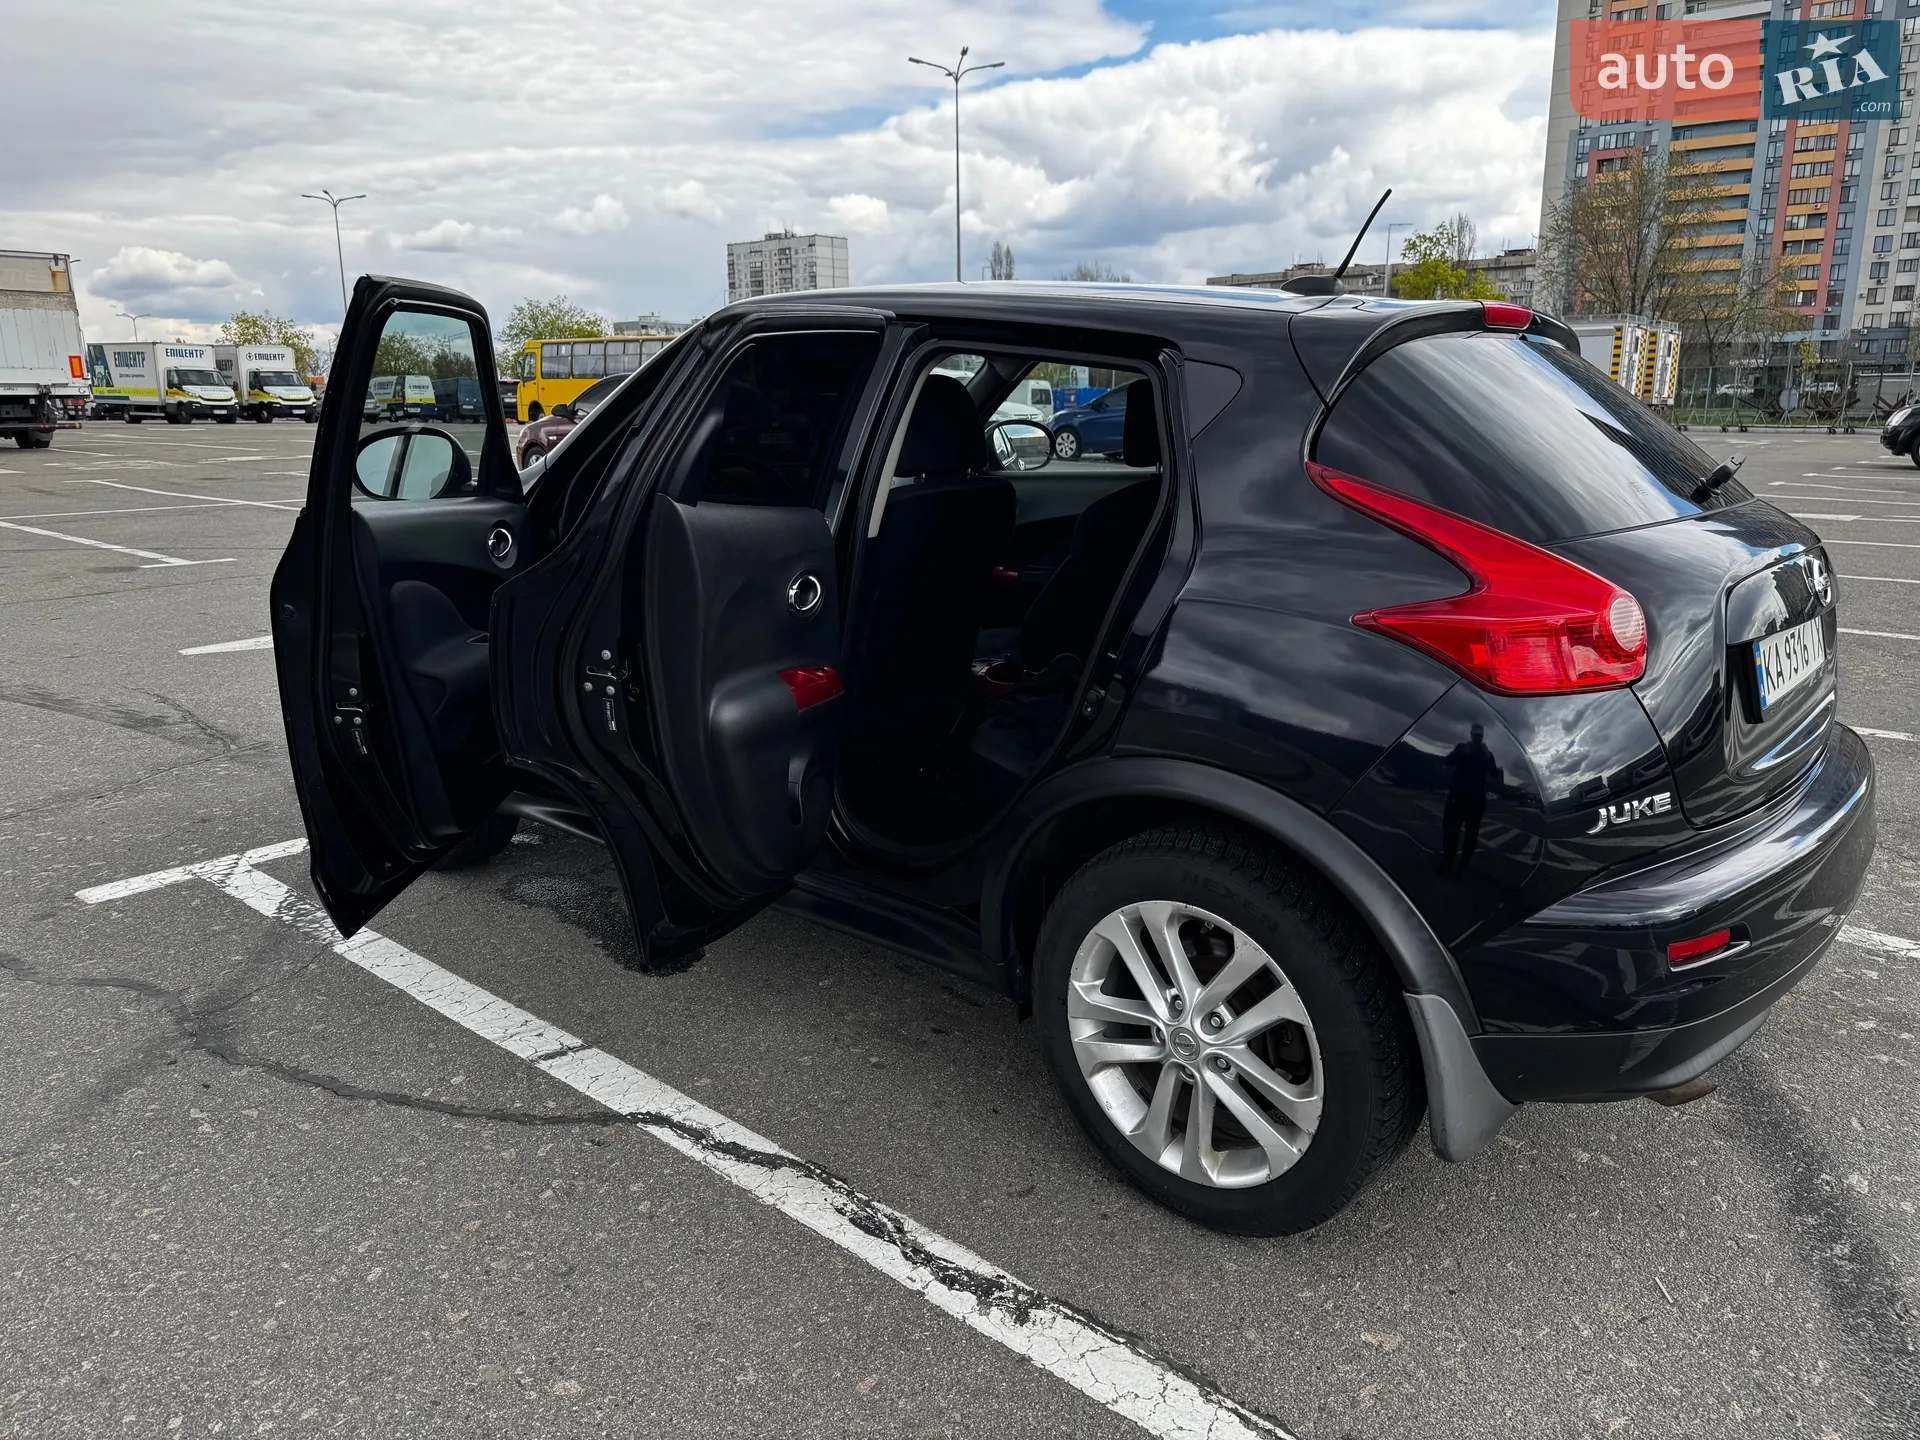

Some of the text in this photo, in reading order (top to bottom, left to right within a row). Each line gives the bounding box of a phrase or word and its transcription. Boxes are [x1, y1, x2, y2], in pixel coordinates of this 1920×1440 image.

[113, 350, 146, 369] ЕПІЦЕНТР
[165, 347, 204, 359] ЕПІЦЕНТР
[254, 352, 285, 361] ЕПІЦЕНТР
[1763, 642, 1785, 694] KA
[1784, 624, 1809, 681] 9316
[1586, 792, 1671, 834] JUKE
[1181, 870, 1281, 935] NEXEN
